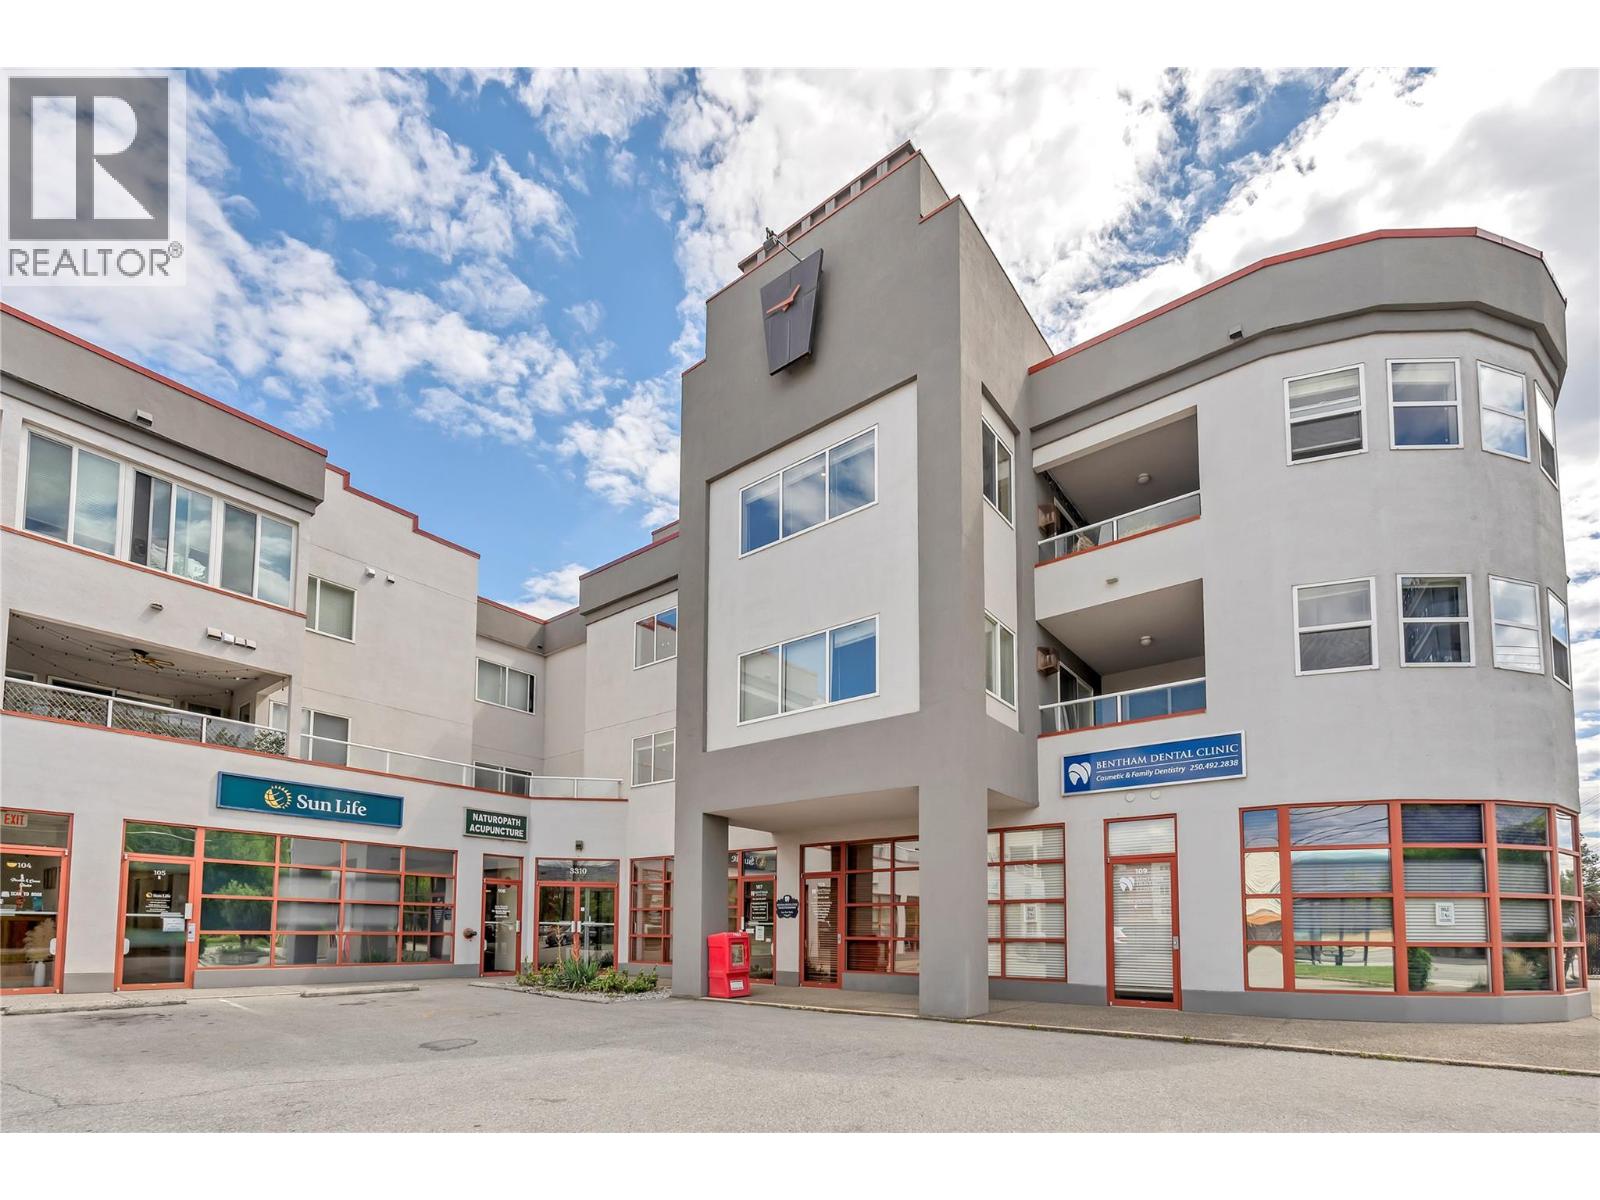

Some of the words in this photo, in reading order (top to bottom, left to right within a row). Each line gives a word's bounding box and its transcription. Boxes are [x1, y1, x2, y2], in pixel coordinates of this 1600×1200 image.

[1096, 756, 1147, 769] BENTHAM
[1150, 748, 1194, 763] DENTAL
[1196, 743, 1239, 757] CLINIC
[1096, 773, 1124, 782] Cosmetic
[1131, 769, 1153, 778] Family
[1154, 766, 1186, 775] Dentistry
[1189, 759, 1239, 771] 250.492.2838
[296, 794, 332, 812] Sun
[335, 798, 368, 817] Life
[4, 813, 24, 825] EXIT
[472, 812, 521, 827] NATUROPATH
[469, 823, 524, 838] ACUPUNCTURE
[569, 867, 588, 875] 3310
